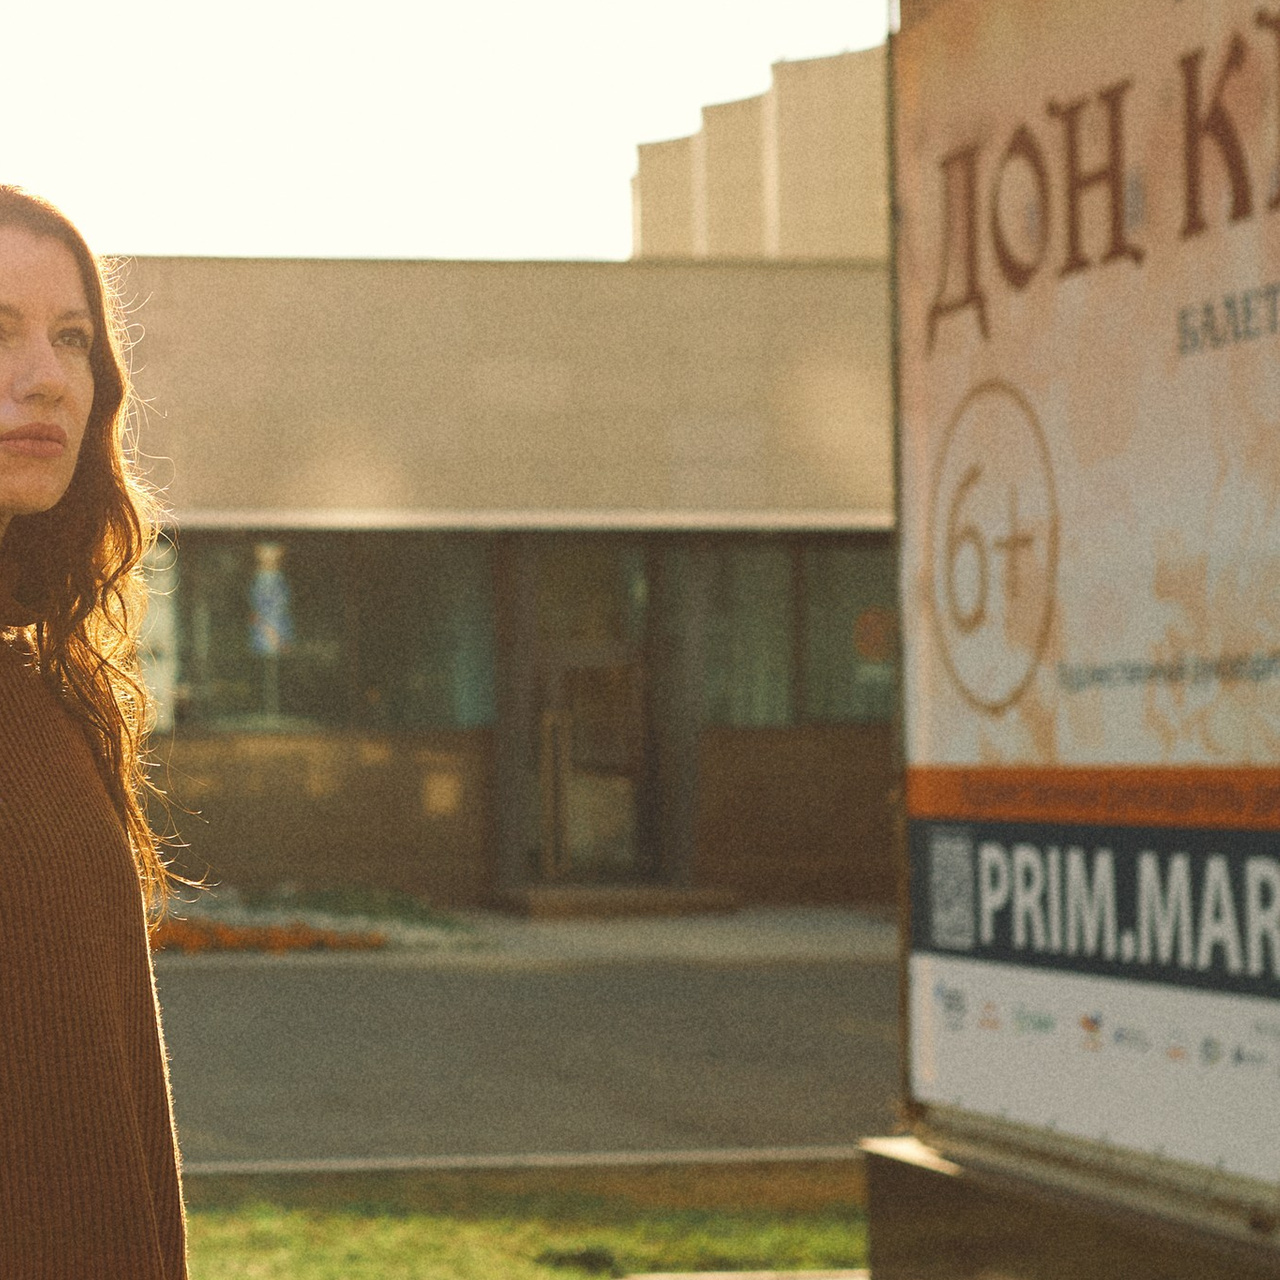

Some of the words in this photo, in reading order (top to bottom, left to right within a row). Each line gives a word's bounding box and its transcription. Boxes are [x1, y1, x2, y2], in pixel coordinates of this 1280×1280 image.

[925, 76, 1145, 358] ДОН
[1179, 8, 1280, 240] К
[946, 464, 1035, 633] 6+
[978, 841, 1280, 982] PRIM.MAR
